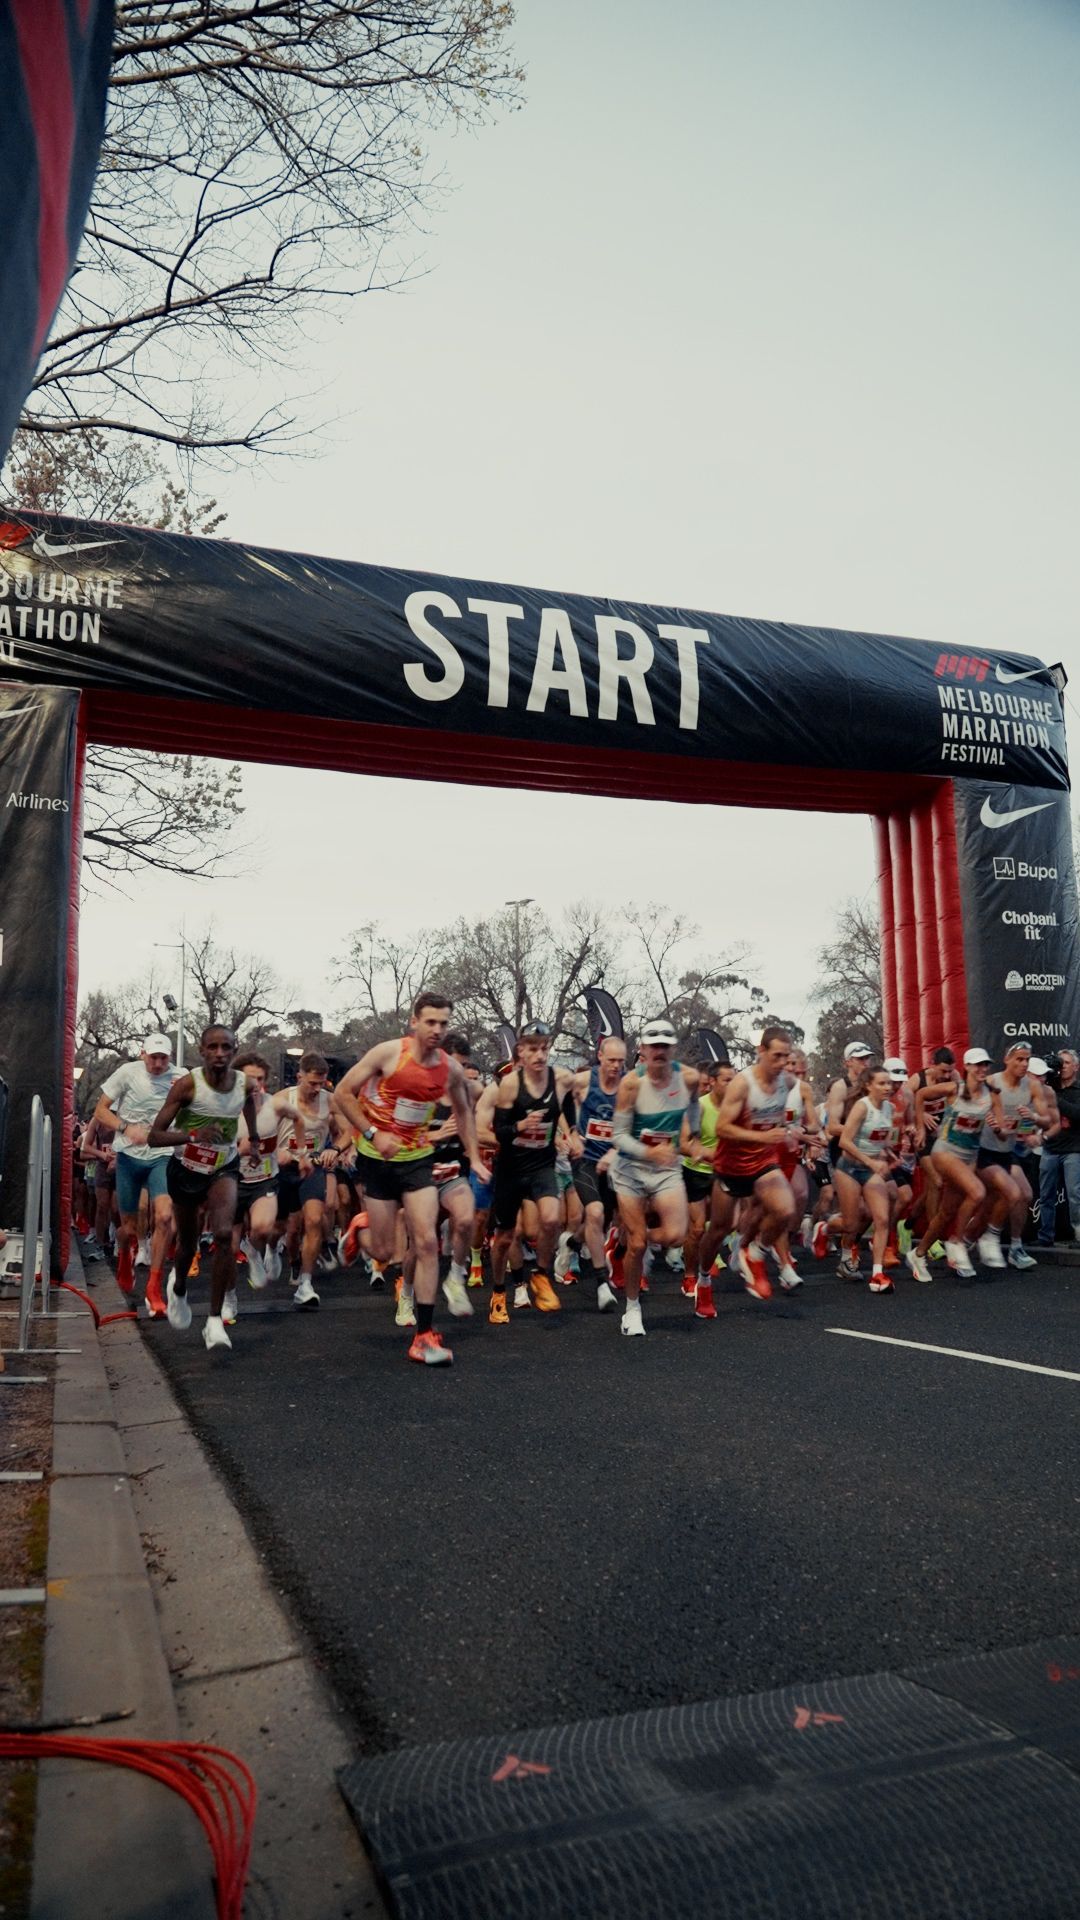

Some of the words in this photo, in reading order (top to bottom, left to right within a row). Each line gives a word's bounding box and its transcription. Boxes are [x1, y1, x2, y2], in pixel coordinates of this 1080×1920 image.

[403, 590, 710, 730] START
[937, 685, 1055, 726] MELBOURNE
[942, 712, 1050, 750] MARATHON
[940, 742, 1006, 766] FESTIVAL
[5, 791, 70, 812] Airlines
[1018, 861, 1057, 881] Bupa
[1001, 910, 1057, 926] Chobani
[1024, 924, 1041, 940] fit
[1024, 973, 1066, 986] PROTEIN
[1003, 1022, 1069, 1037] GARMIN
